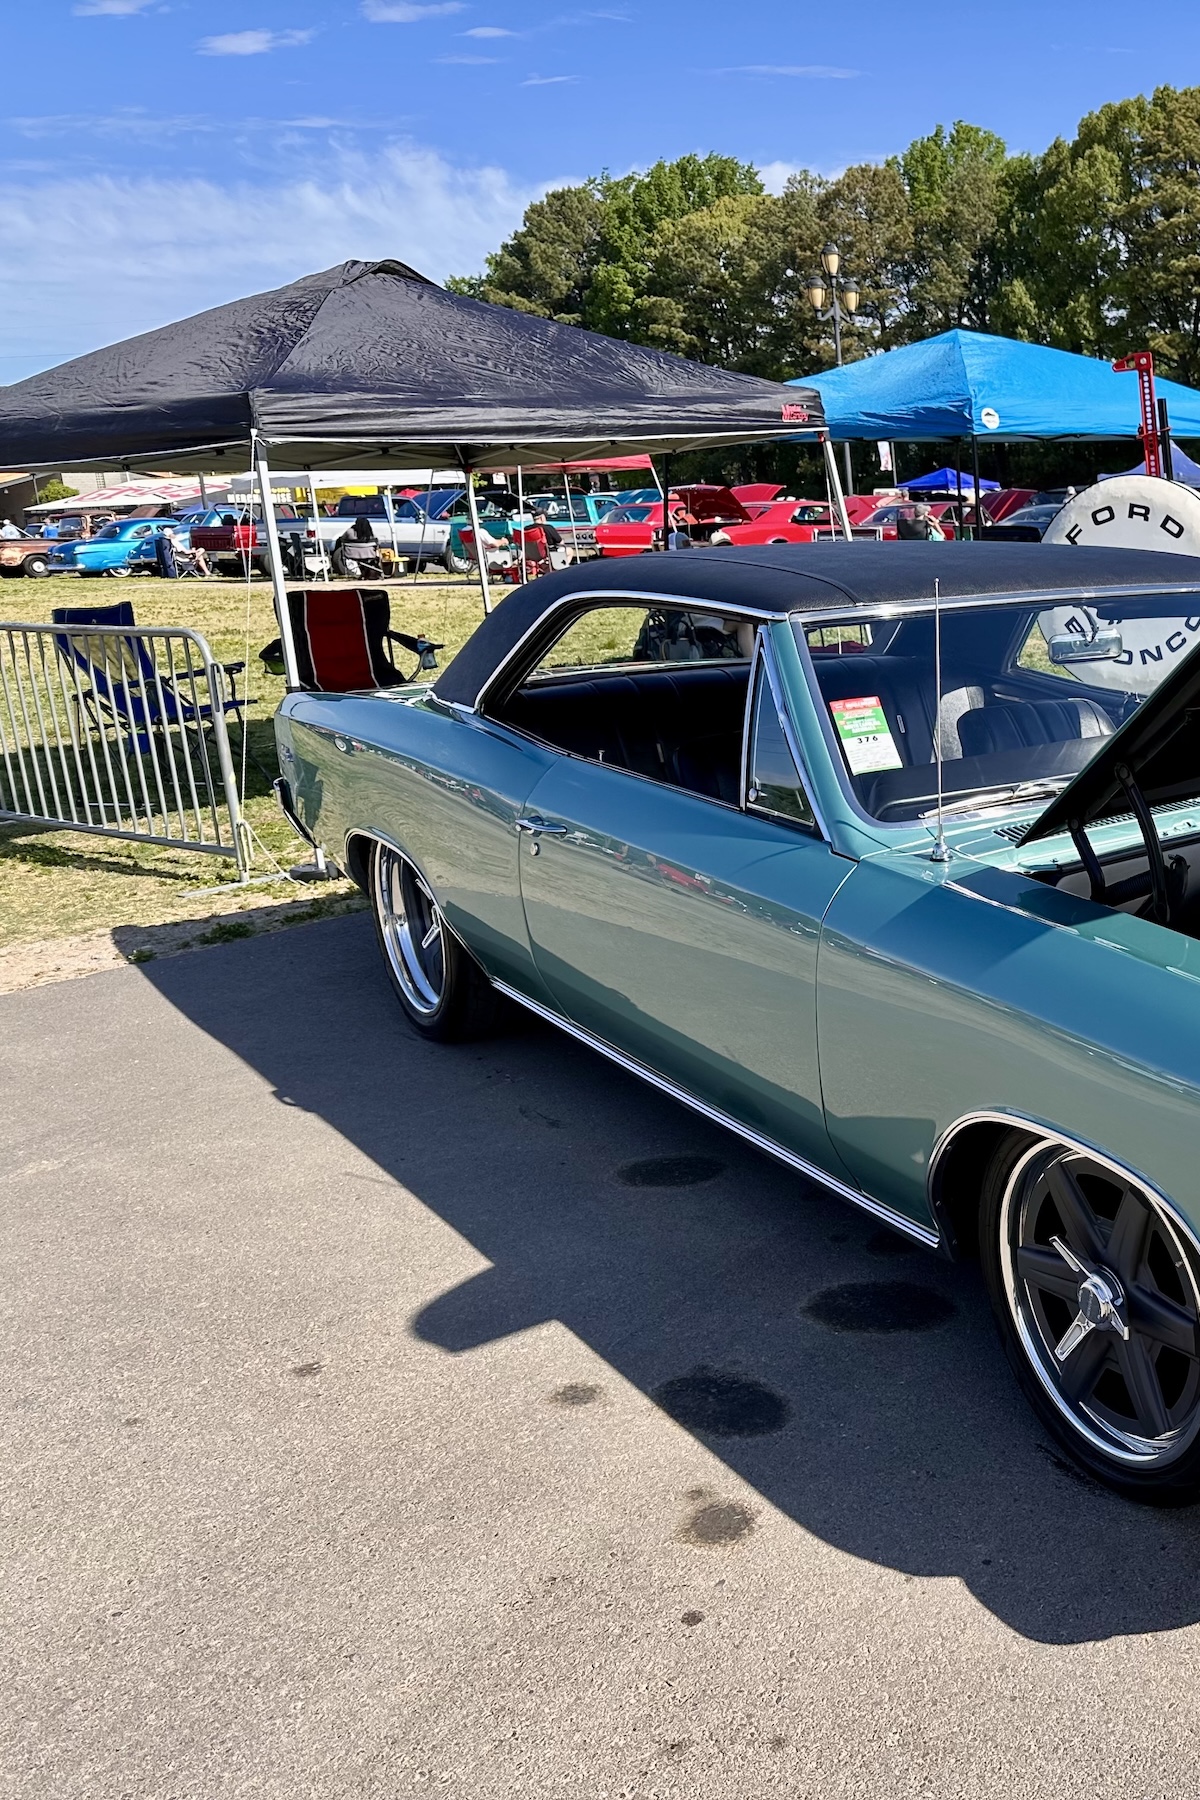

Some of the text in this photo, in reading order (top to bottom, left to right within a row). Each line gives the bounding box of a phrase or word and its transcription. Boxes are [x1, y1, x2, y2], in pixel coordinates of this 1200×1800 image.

[227, 492, 293, 503] MERCHDISE
[1065, 503, 1185, 545] FORD
[857, 735, 878, 744] 376
